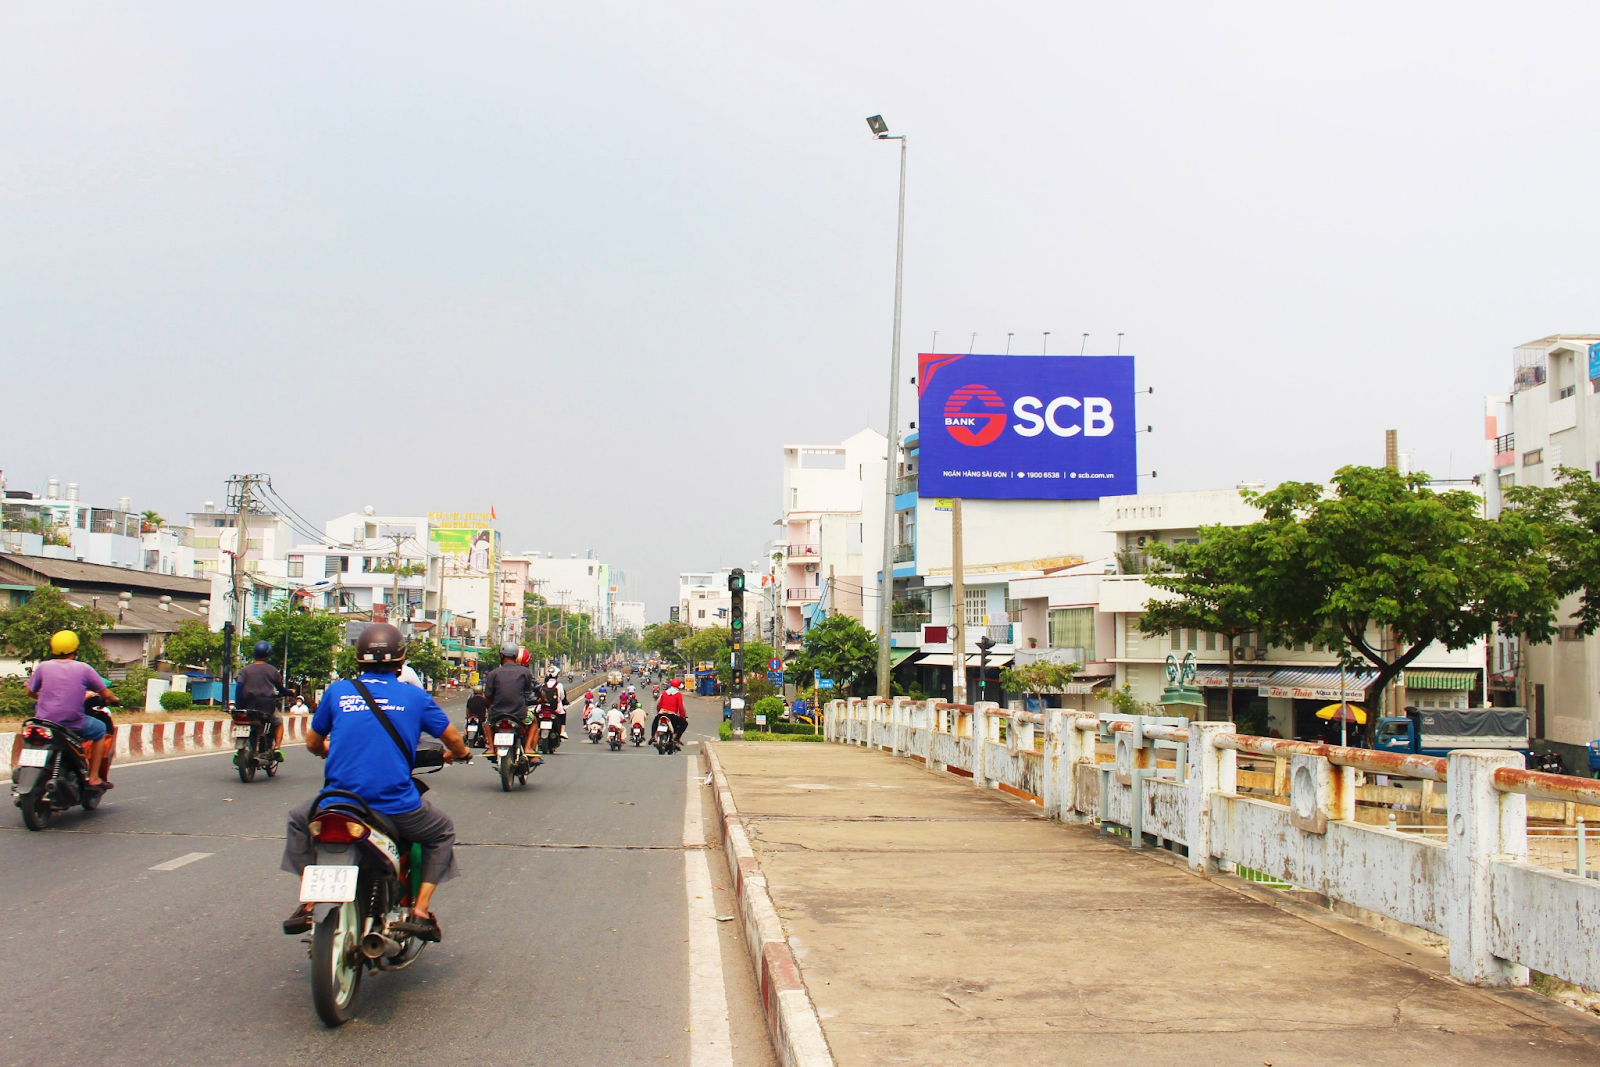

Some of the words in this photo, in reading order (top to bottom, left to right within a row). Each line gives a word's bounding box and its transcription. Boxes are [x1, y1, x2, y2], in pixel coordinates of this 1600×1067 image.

[945, 417, 975, 426] BANK
[1013, 396, 1114, 437] SCB
[943, 470, 961, 478] NGÂN
[962, 470, 981, 478] HÀNG
[981, 470, 992, 478] SÀI
[992, 470, 1007, 478] GÒN
[1026, 471, 1043, 479] 1900
[1043, 471, 1060, 479] 6538
[1078, 471, 1114, 479] scb.com.vn
[311, 868, 348, 883] 54-K1
